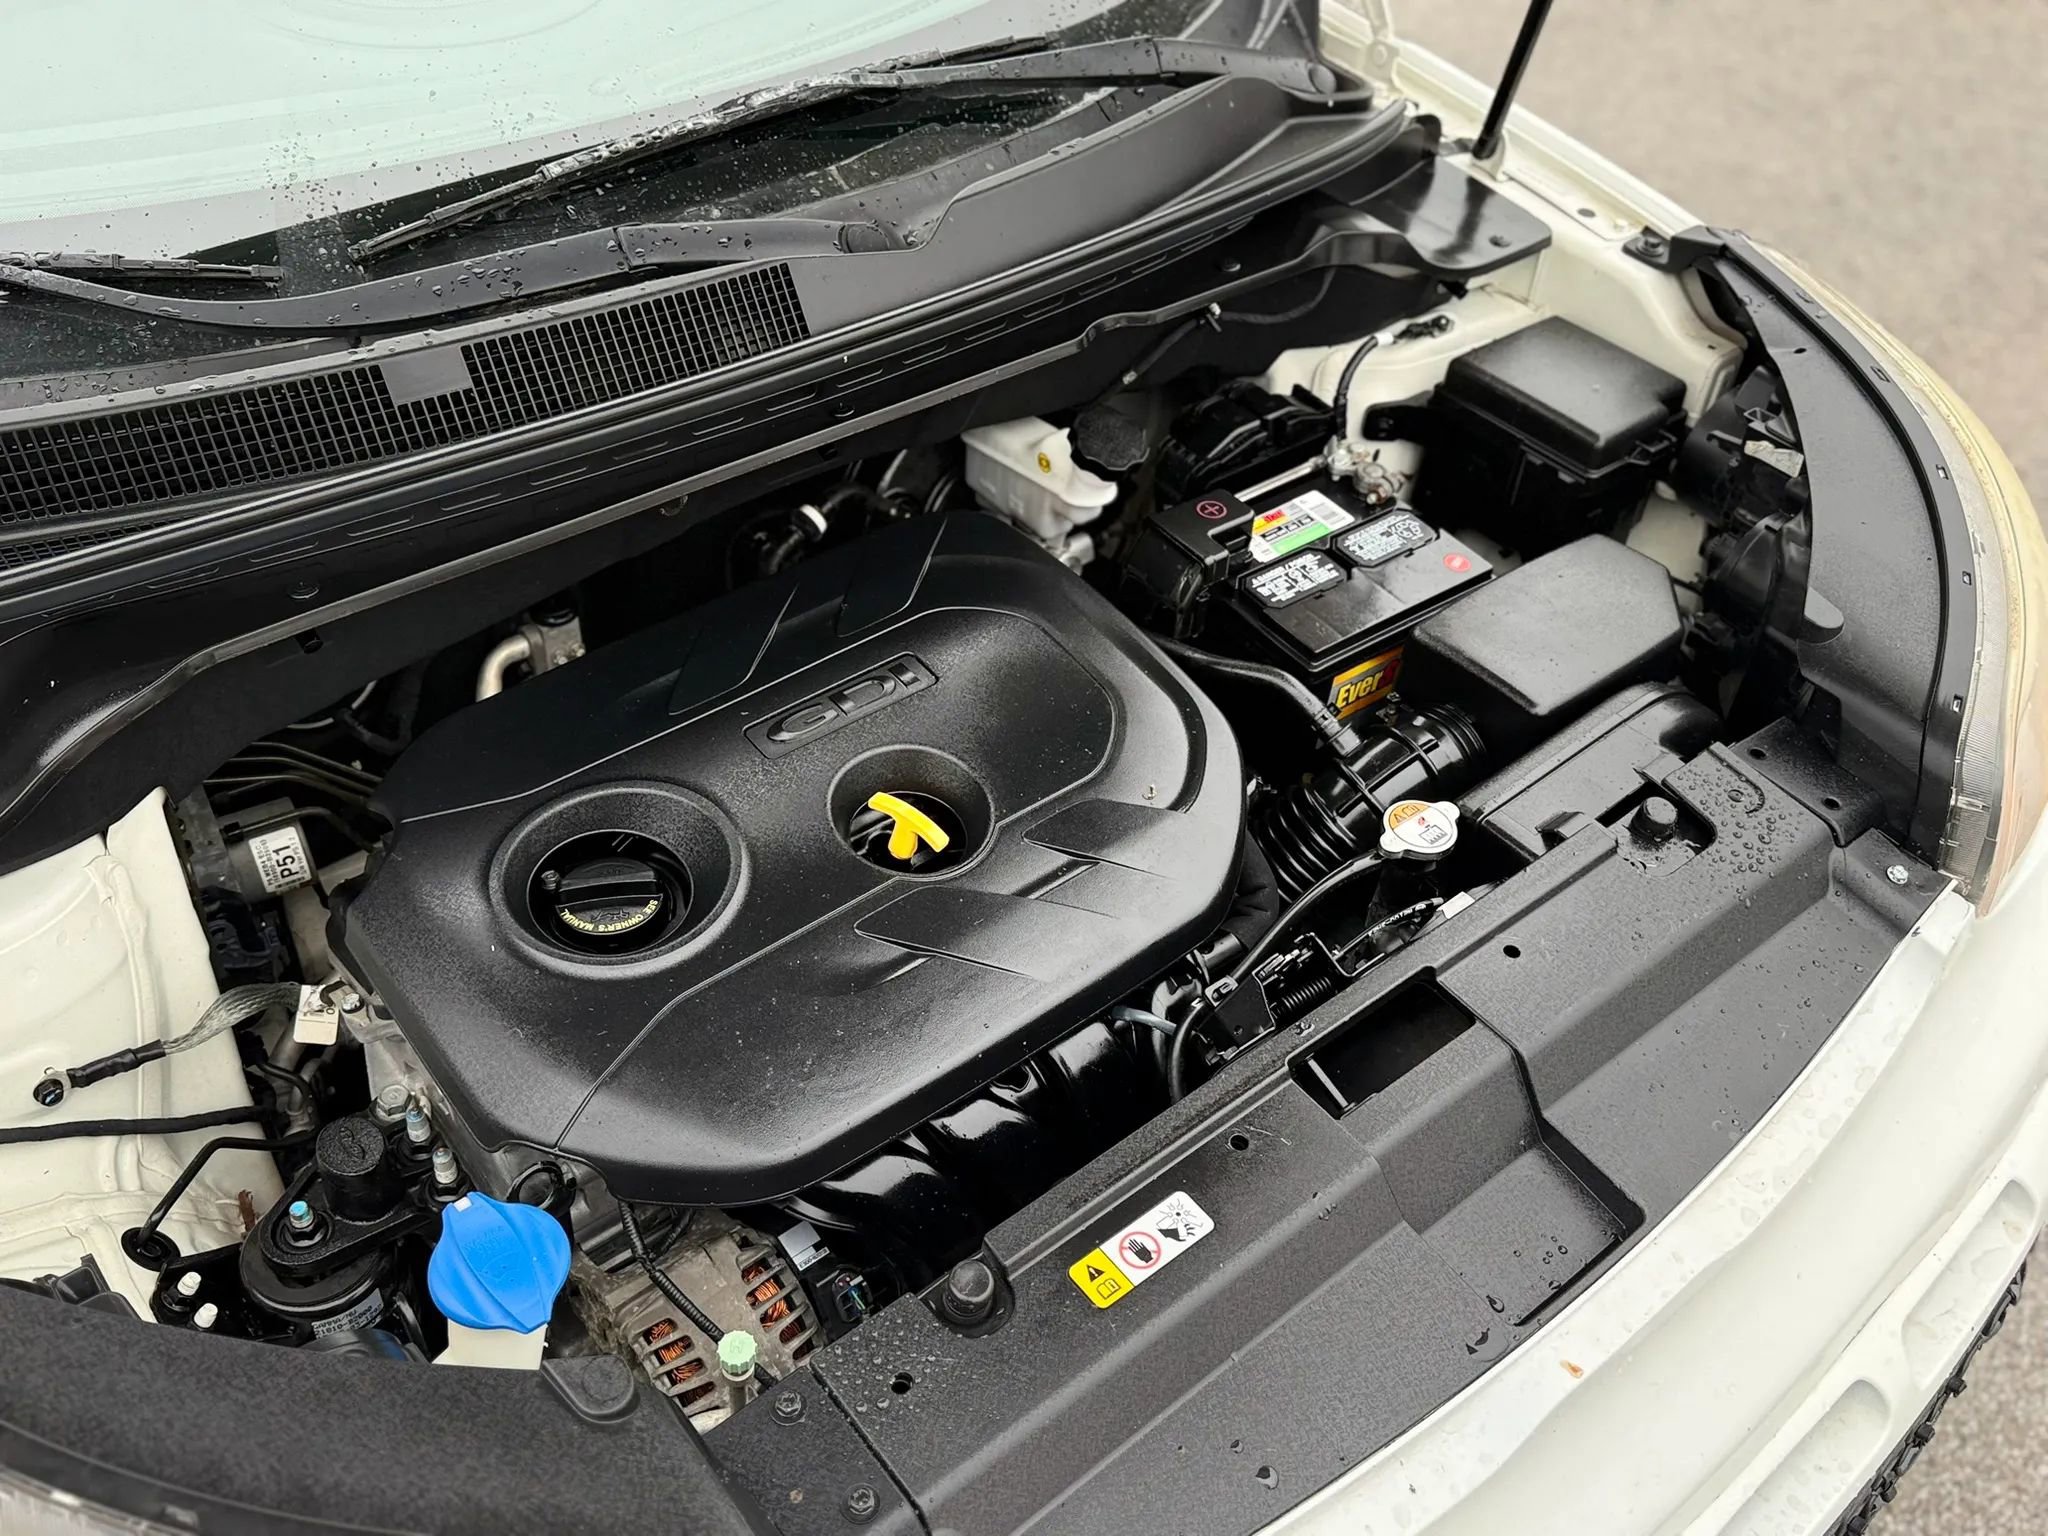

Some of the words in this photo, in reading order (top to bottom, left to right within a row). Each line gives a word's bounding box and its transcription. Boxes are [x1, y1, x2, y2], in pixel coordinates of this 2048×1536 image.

[766, 661, 921, 744] GDI
[1336, 670, 1384, 708] Ever
[272, 845, 300, 879] P51
[560, 908, 595, 932] MANUAL
[642, 899, 659, 915] SEE
[598, 913, 644, 932] OWNER'S
